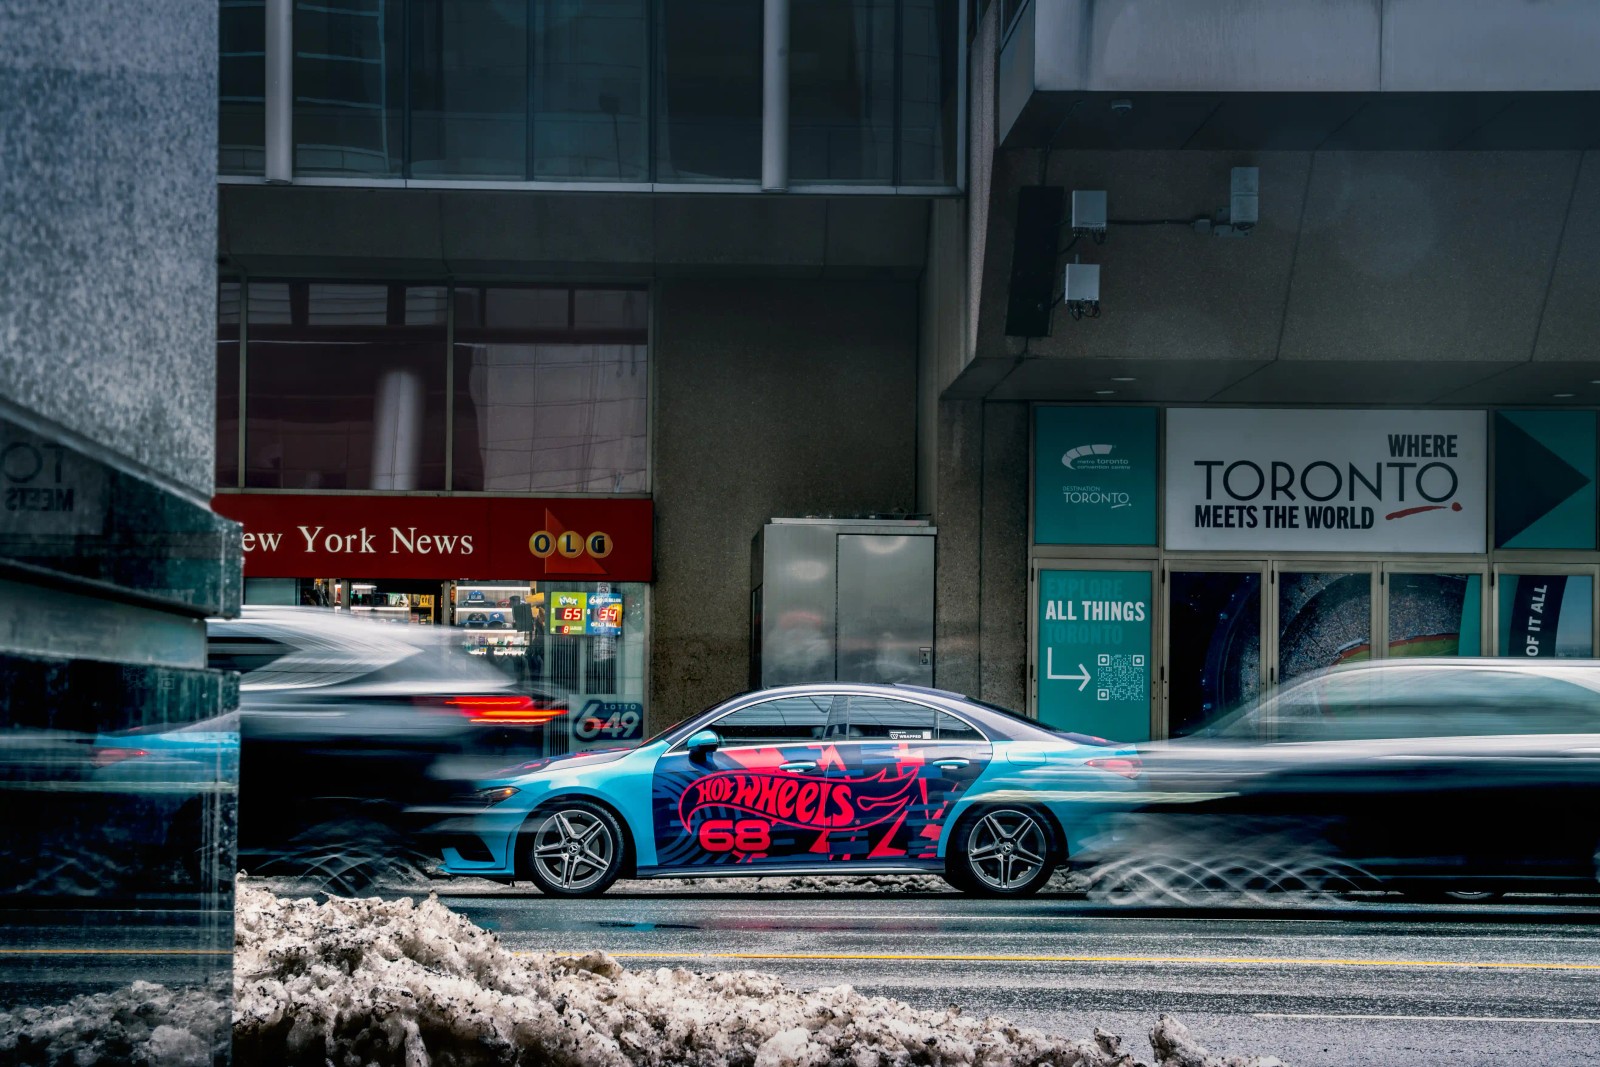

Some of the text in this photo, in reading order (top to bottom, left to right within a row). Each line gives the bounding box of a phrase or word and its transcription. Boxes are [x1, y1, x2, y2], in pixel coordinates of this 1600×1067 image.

[1388, 434, 1458, 458] WHERE
[1194, 460, 1458, 502] TORONTO
[1064, 492, 1129, 504] TORONTO
[1195, 505, 1374, 529] MEETS THE WORLD
[242, 526, 474, 555] ew York News
[532, 533, 608, 555] OLG
[1046, 579, 1123, 599] EXPLORE
[564, 608, 581, 620] 65
[600, 609, 616, 620] 34
[1046, 600, 1145, 621] ALL THINGS
[1526, 585, 1547, 656] OF IT ALL
[1046, 624, 1123, 644] TORONTO
[576, 704, 640, 738] 649
[700, 820, 771, 851] 68
